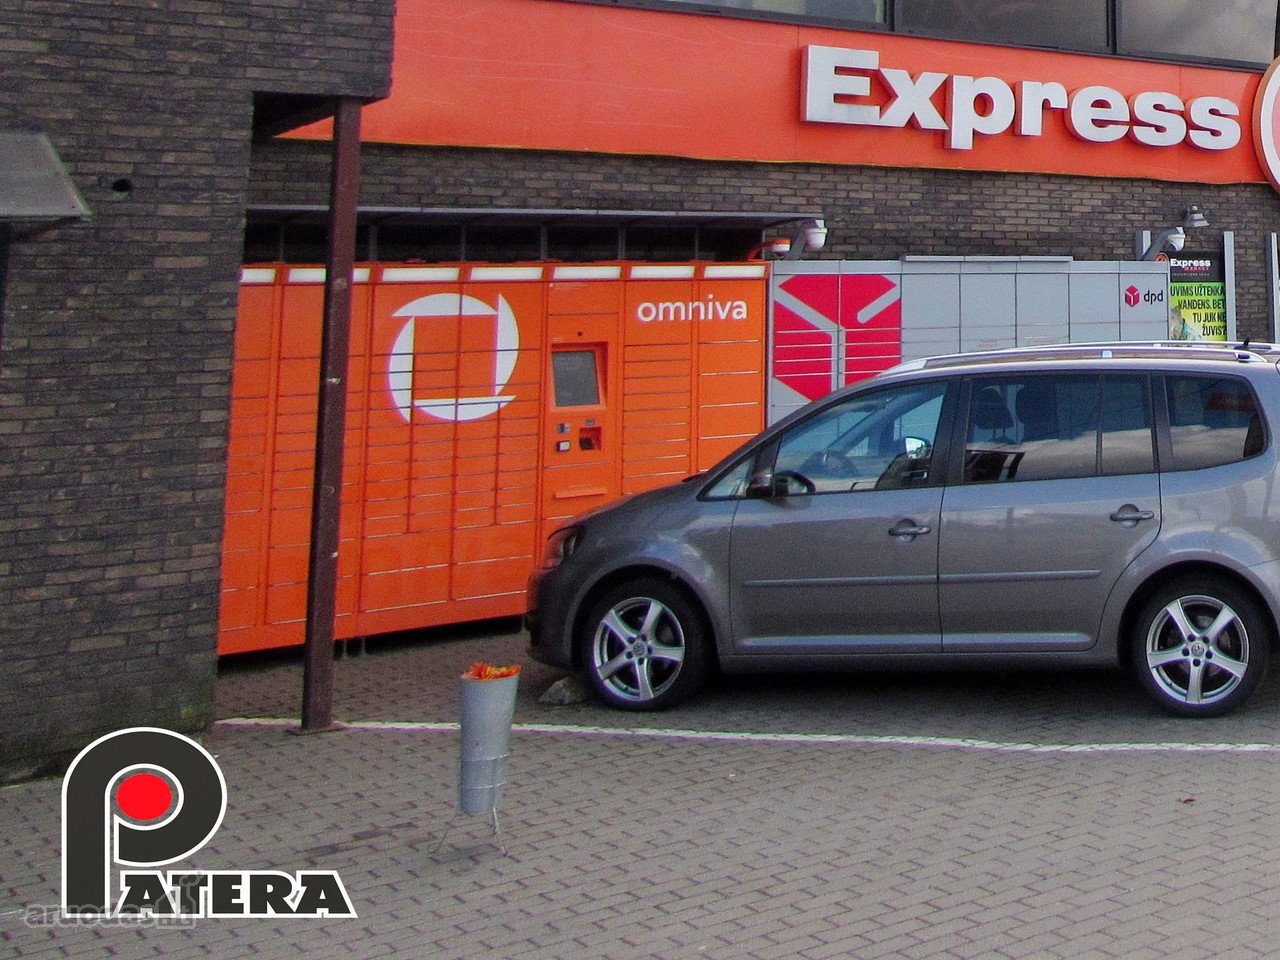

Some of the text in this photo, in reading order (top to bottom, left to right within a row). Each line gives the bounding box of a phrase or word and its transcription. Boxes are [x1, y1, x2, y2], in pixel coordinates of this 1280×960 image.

[802, 43, 1242, 150] Express
[1170, 258, 1211, 268] Express
[1143, 290, 1164, 305] dpd
[1170, 286, 1194, 297] UVIMS
[636, 293, 748, 322] omniva
[1193, 312, 1202, 322] TU
[1203, 312, 1217, 322] JUK
